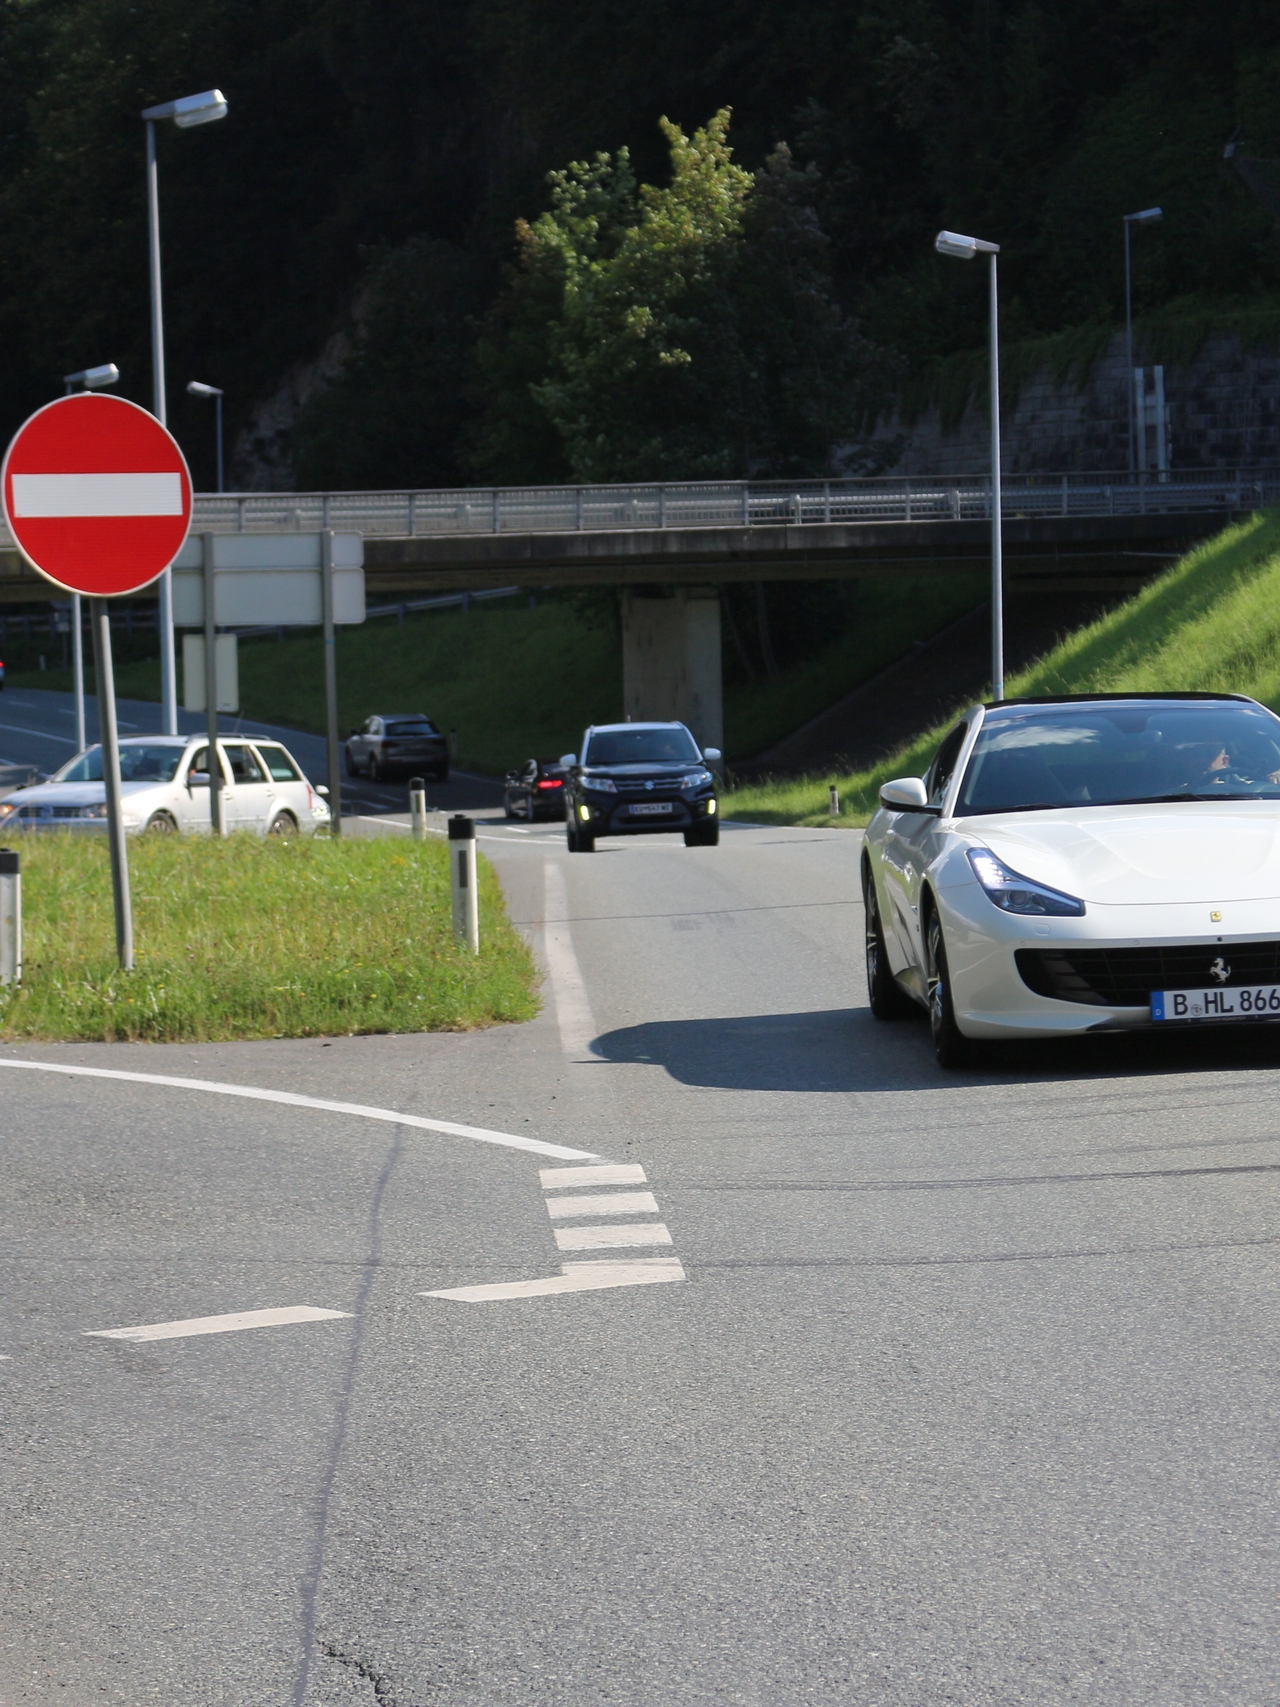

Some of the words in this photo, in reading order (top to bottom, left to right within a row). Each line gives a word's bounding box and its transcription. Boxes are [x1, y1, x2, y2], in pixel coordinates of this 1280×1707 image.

[1174, 994, 1188, 1016] B
[1204, 992, 1234, 1014] HL
[1240, 989, 1280, 1012] 866
